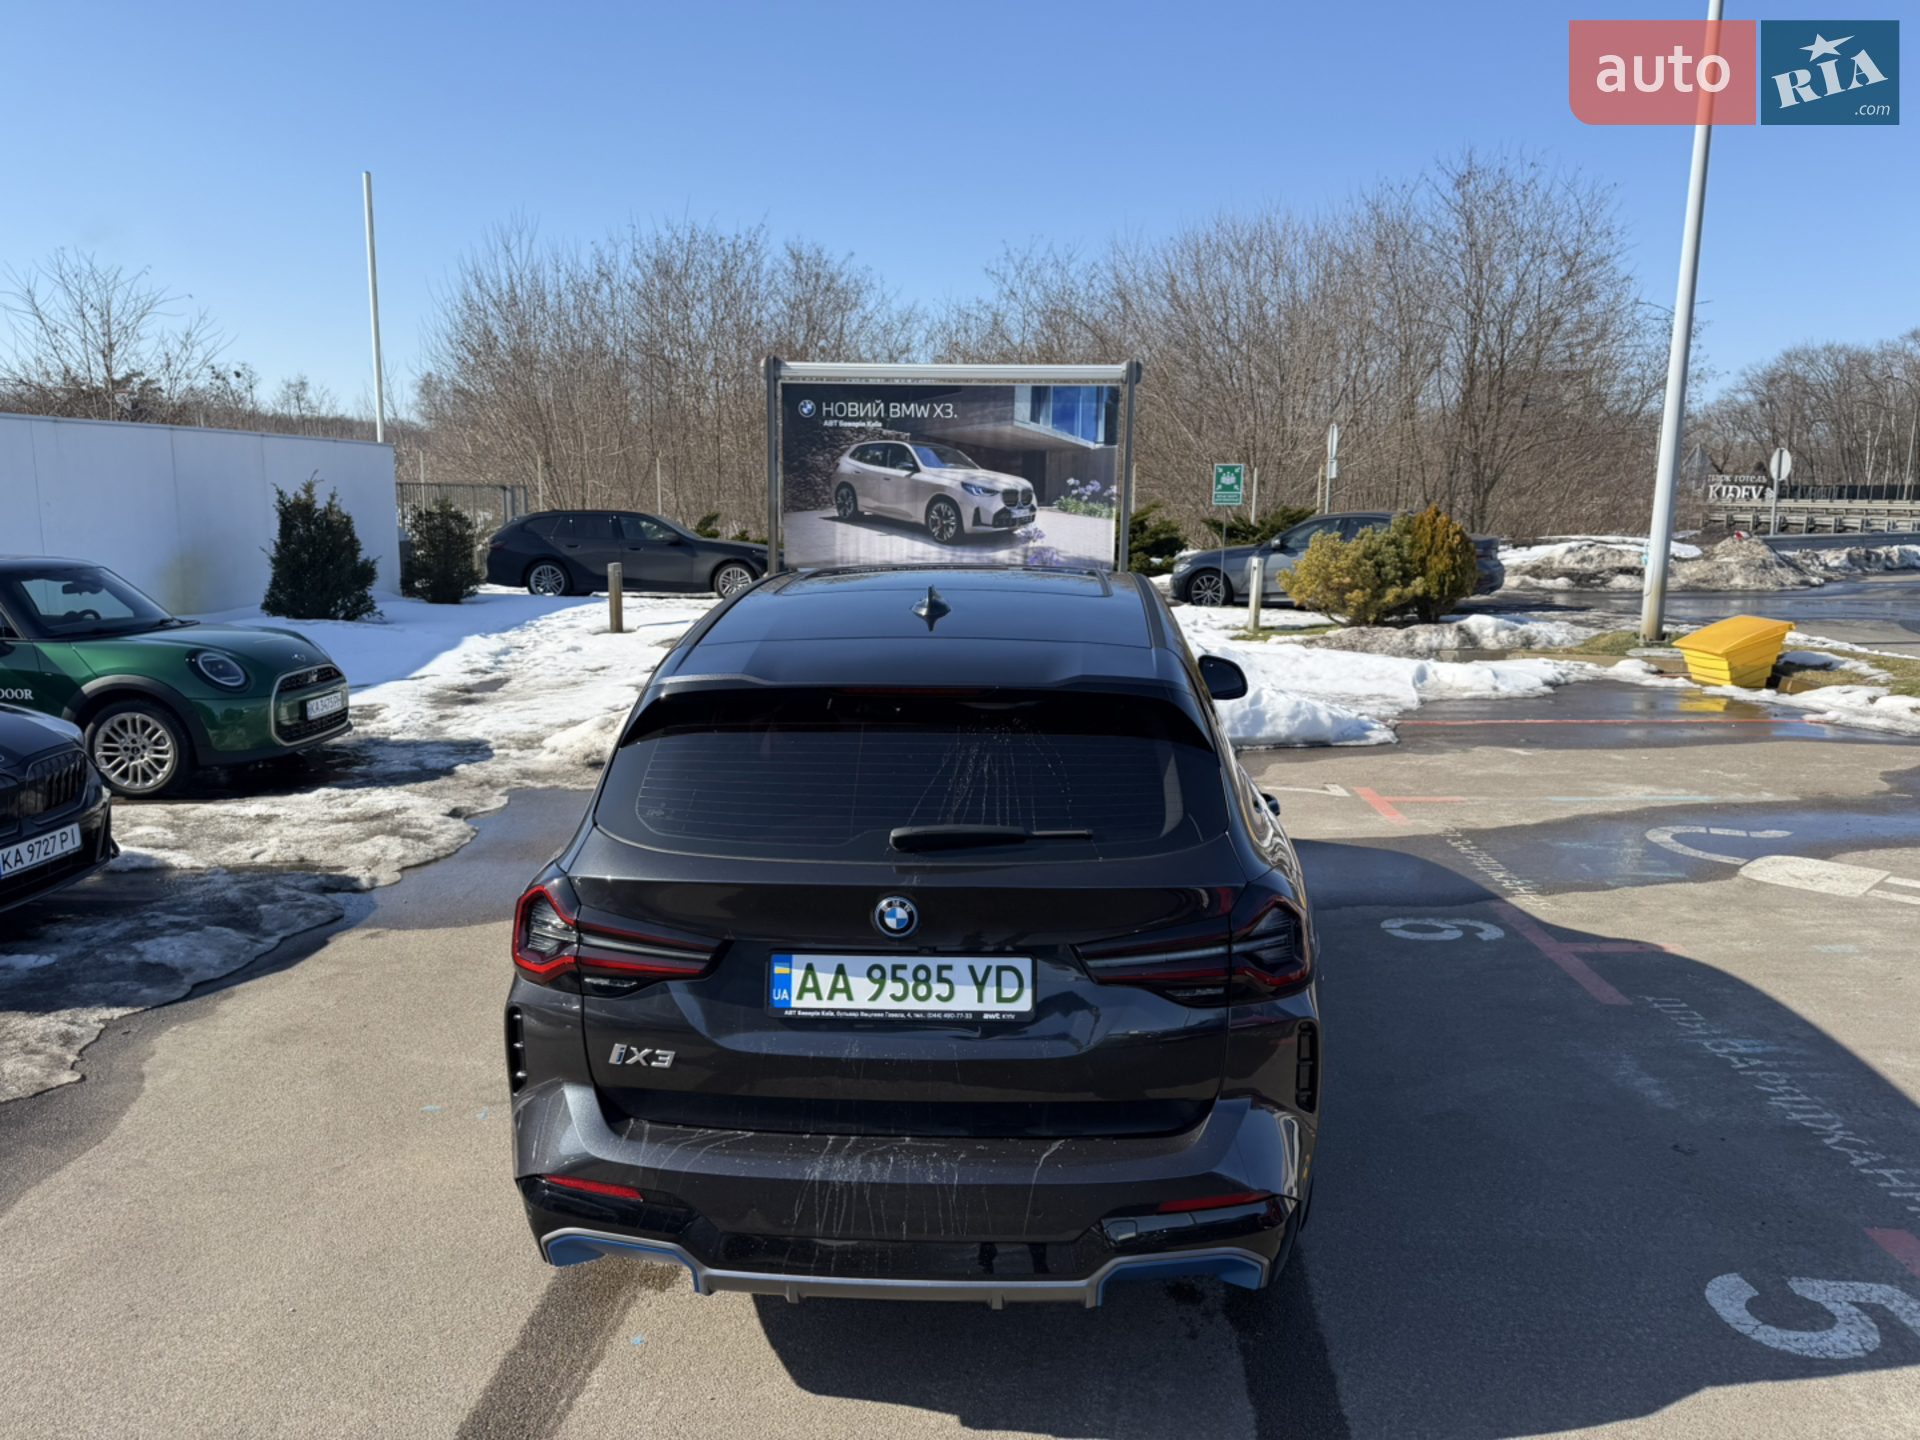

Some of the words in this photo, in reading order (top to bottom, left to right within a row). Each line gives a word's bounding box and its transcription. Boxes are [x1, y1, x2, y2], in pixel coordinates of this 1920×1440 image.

[822, 400, 884, 418] НОВИЙ
[889, 402, 930, 418] BMW
[933, 403, 958, 419] X3.
[1, 850, 24, 872] KA
[27, 834, 57, 862] 9727
[1380, 917, 1505, 941] 6
[773, 988, 790, 1001] UA
[796, 962, 854, 1002] AA
[866, 963, 955, 1003] 9585
[968, 964, 1025, 1004] YD
[608, 1043, 676, 1069] iX3
[1704, 1272, 1920, 1360] 5
